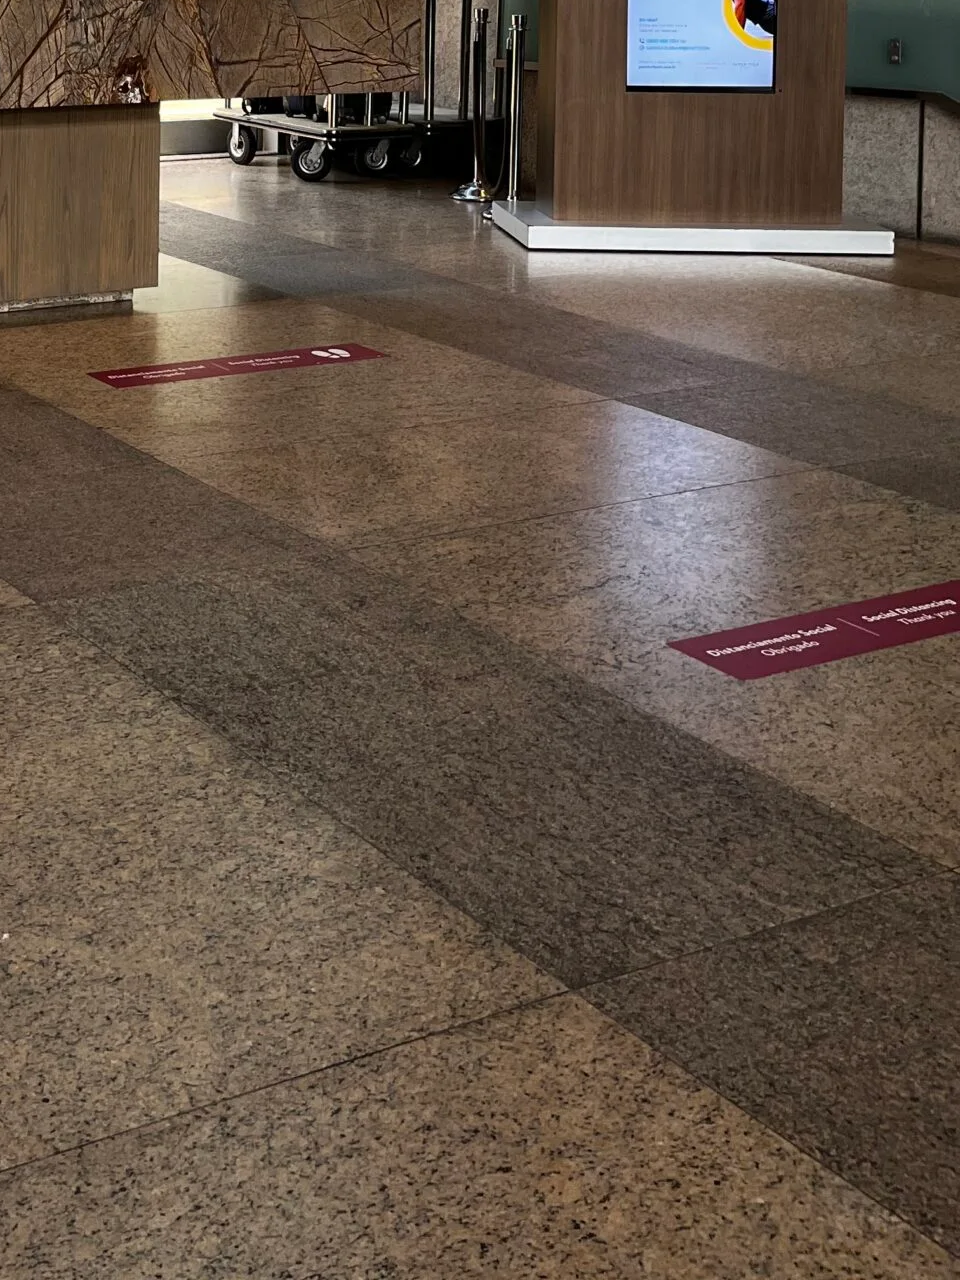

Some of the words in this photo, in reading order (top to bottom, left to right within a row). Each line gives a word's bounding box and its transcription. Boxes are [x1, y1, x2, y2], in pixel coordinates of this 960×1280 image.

[861, 610, 900, 624] Social
[896, 597, 957, 615] Distancing
[897, 612, 935, 626] Thank
[935, 608, 957, 621] you
[706, 631, 801, 658] Distanciamento
[797, 623, 839, 638] Social
[761, 639, 820, 658] Obrigado
